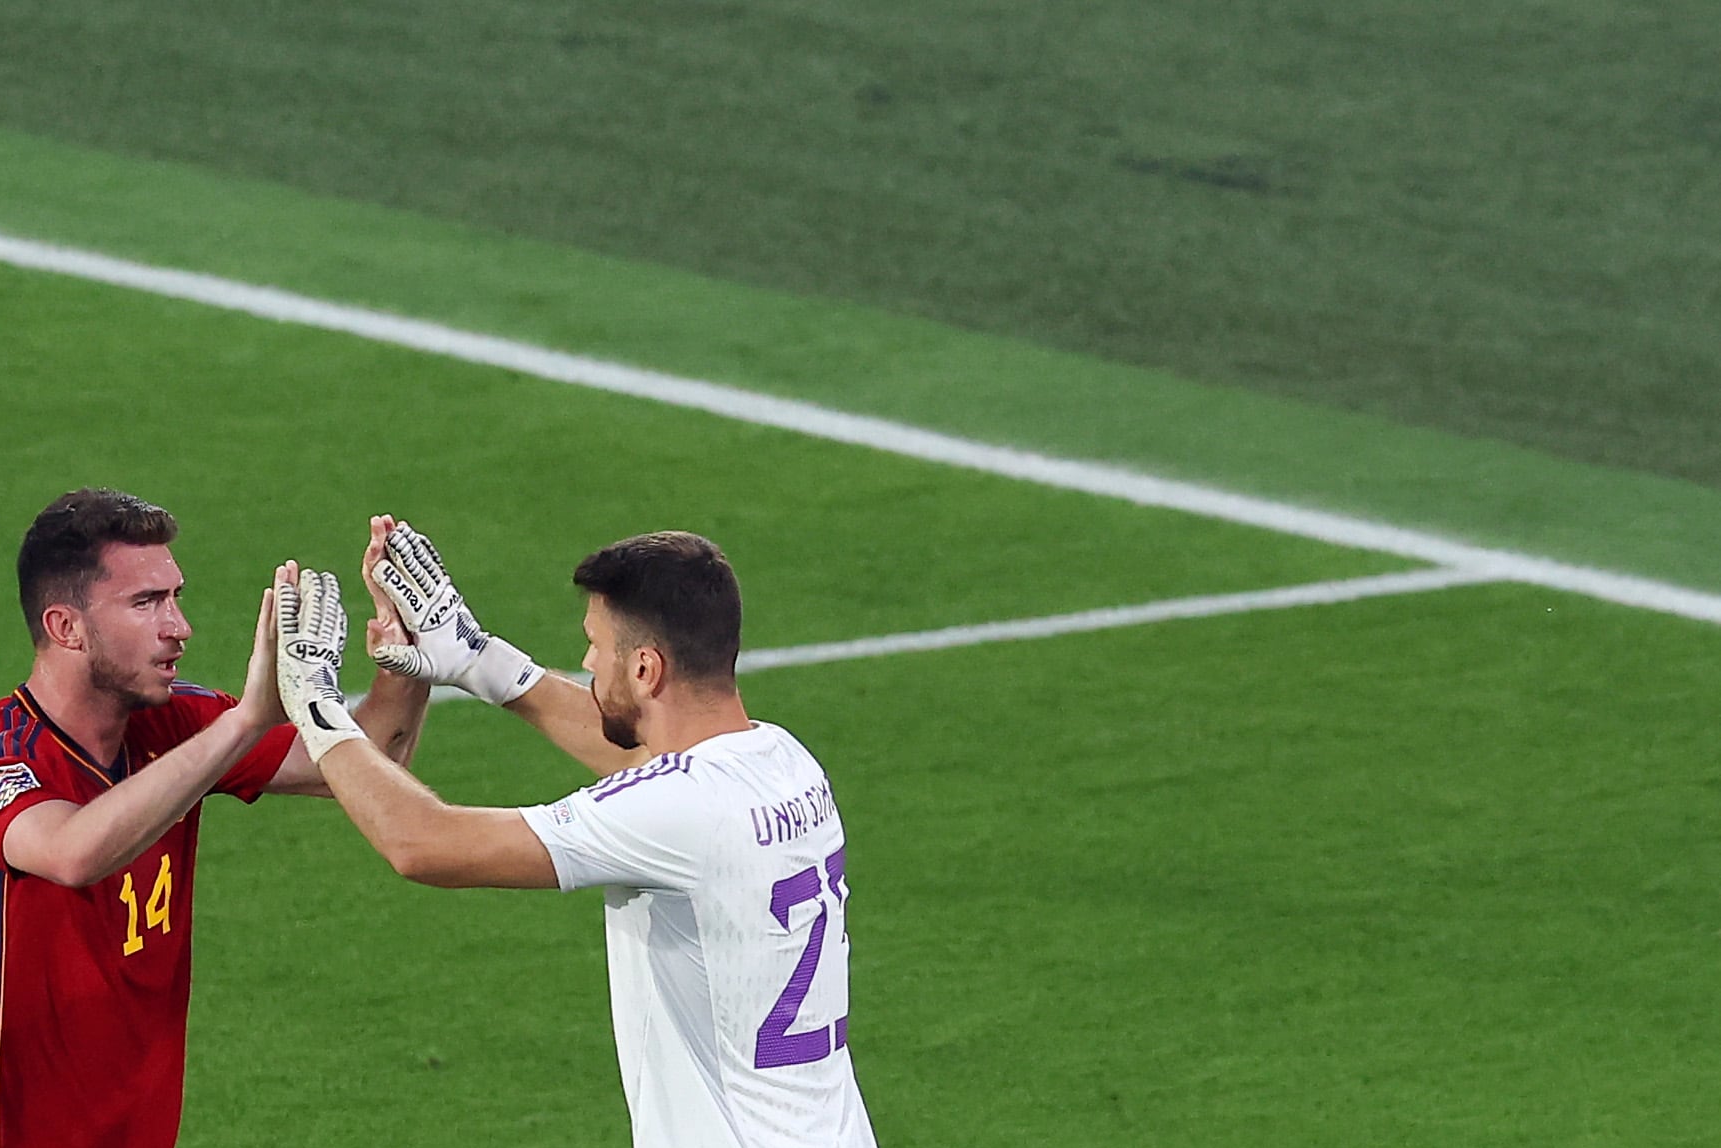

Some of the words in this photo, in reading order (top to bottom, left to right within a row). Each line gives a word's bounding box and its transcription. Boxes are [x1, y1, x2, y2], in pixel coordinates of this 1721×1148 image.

[382, 564, 424, 613] reusch
[750, 797, 808, 846] UNAI
[805, 779, 835, 828] SIM
[119, 853, 172, 956] 14
